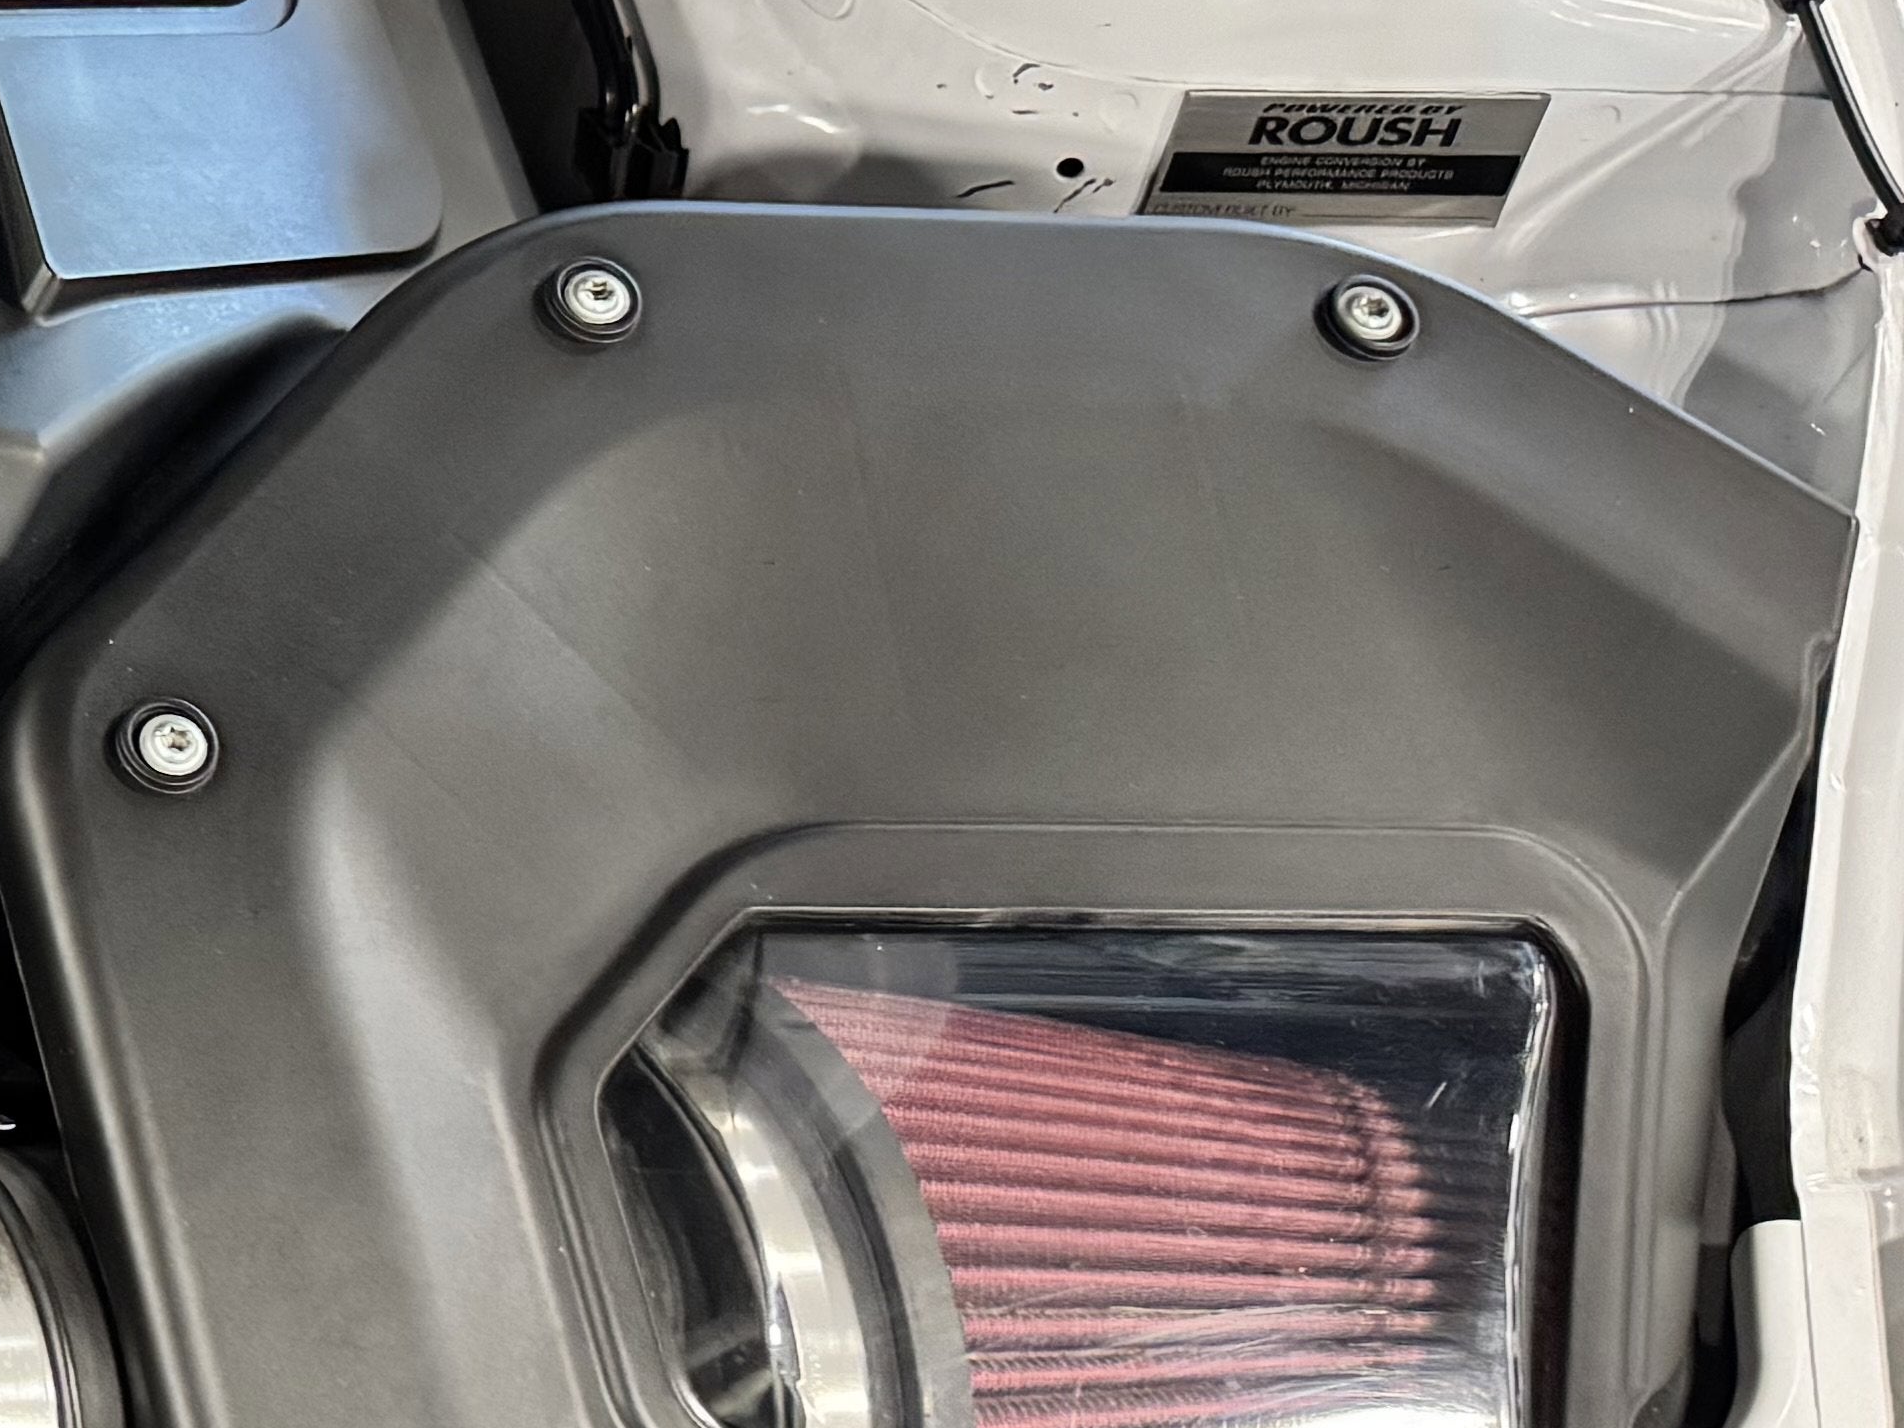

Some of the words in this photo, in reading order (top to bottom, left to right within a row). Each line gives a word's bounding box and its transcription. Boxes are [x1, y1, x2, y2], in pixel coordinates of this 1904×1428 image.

[1262, 103, 1417, 114] POWERED
[1420, 104, 1466, 115] BY
[1248, 116, 1463, 148] ROUSH
[1260, 156, 1313, 167] ENGINE
[1315, 156, 1402, 167] CONVERSION
[1223, 167, 1271, 178] ROUSH
[1274, 167, 1378, 179] PERFORMANCE
[1380, 169, 1455, 180] PRODUCTS
